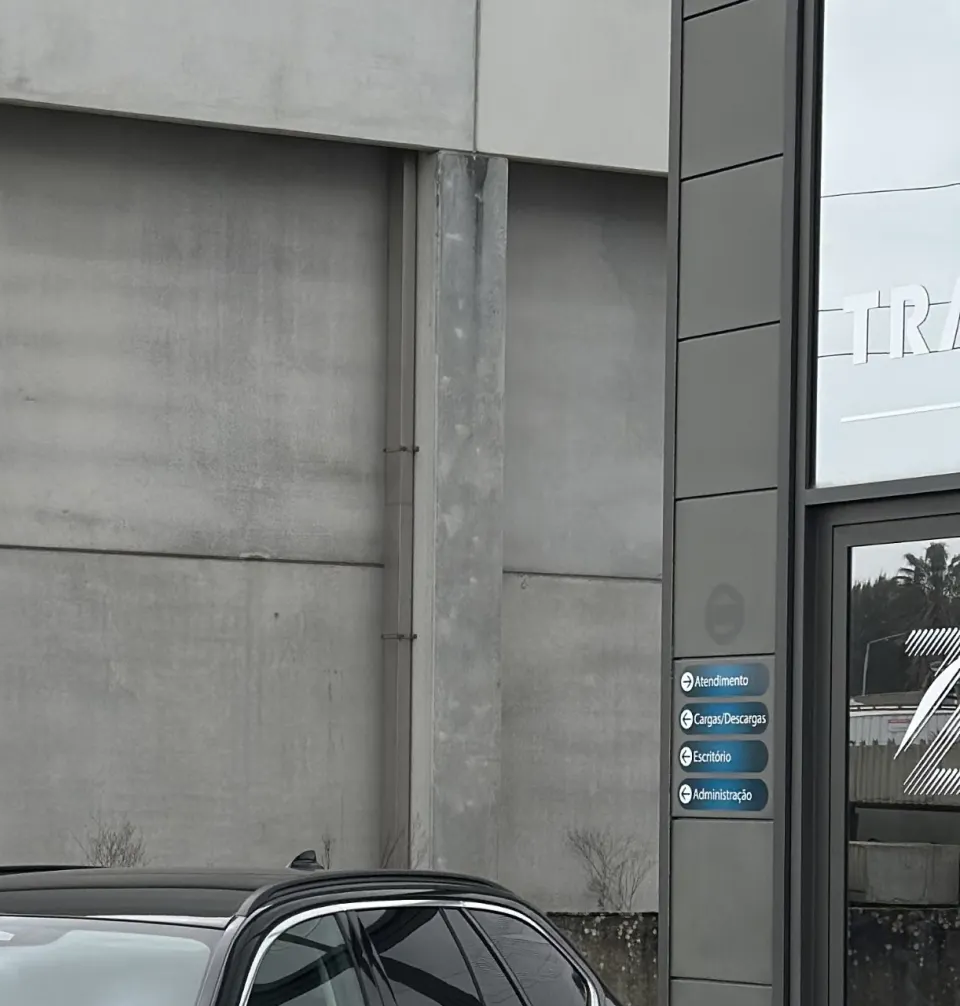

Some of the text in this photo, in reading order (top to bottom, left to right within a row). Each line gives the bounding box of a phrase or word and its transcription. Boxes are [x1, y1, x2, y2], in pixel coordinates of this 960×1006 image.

[694, 674, 749, 688] Atendimento
[693, 712, 767, 729] Cargas/Descargas
[693, 750, 732, 764] Escritório
[692, 788, 753, 803] Administração
